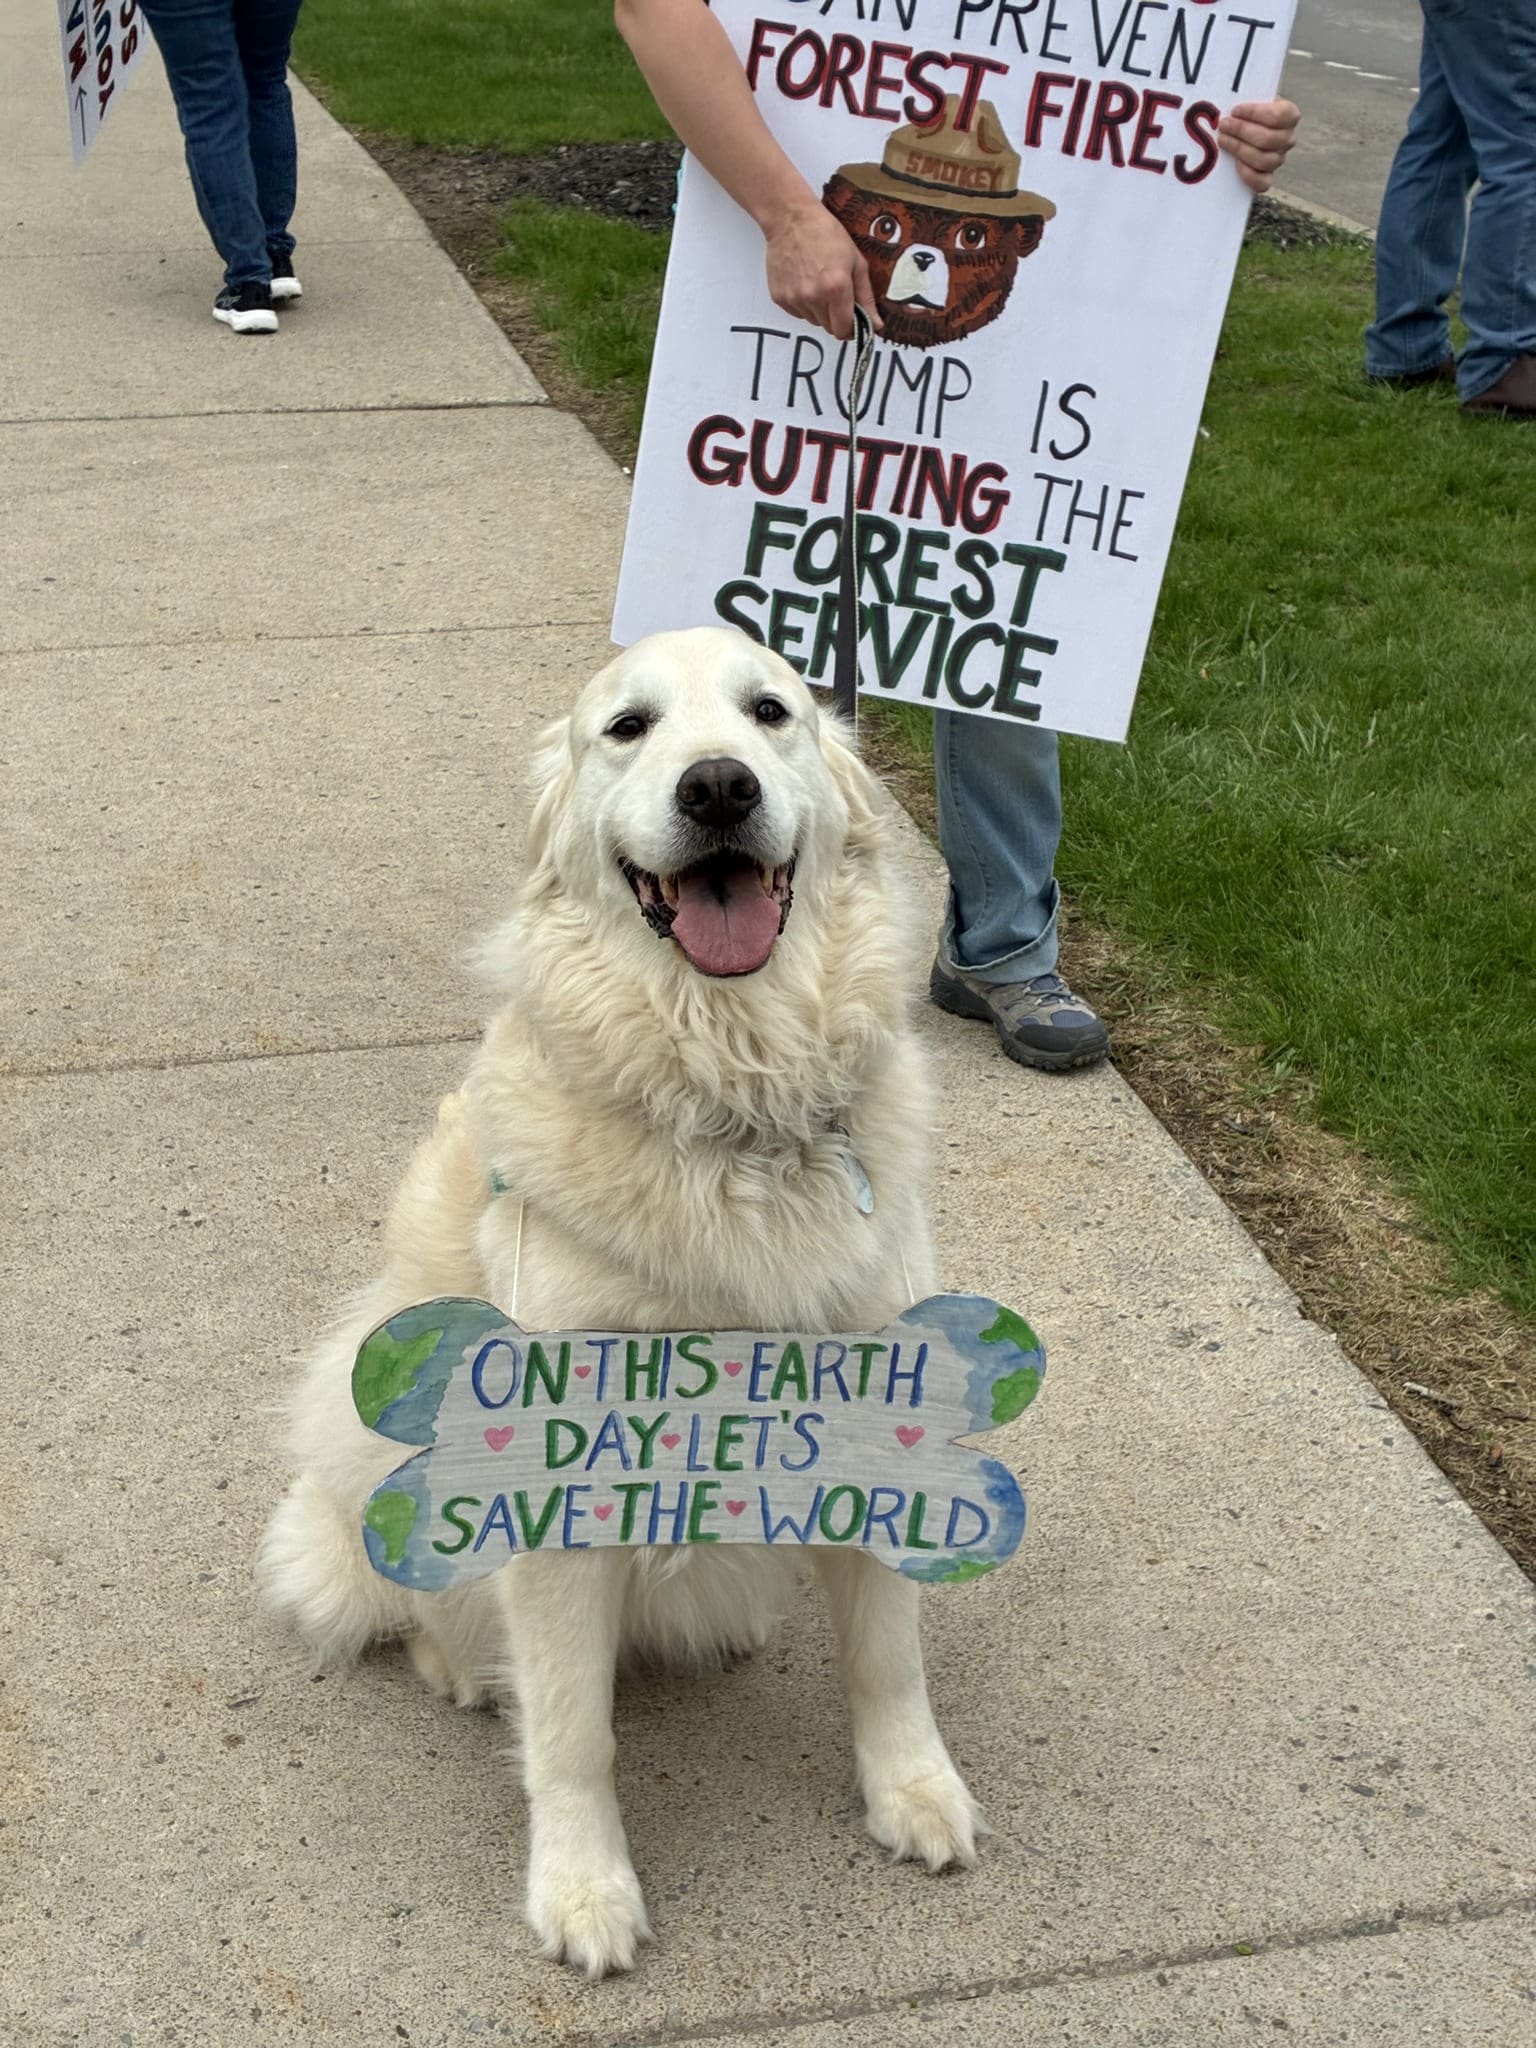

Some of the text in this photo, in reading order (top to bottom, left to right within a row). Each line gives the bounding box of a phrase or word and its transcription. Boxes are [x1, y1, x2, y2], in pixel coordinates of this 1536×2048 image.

[954, 0, 1275, 92] PREVENT
[746, 18, 1221, 185] FOREST FIRES
[905, 150, 1006, 191] SMOKEY
[730, 326, 1097, 461] TRUMP IS
[687, 414, 1146, 563] GUTTING THE
[743, 501, 1067, 627] FOREST
[714, 579, 1059, 722] SERVICE
[471, 1335, 930, 1410] ON THIS EARTH
[545, 1410, 826, 1472] DAY LET'S
[432, 1480, 991, 1555] SAVE THE WORLD
